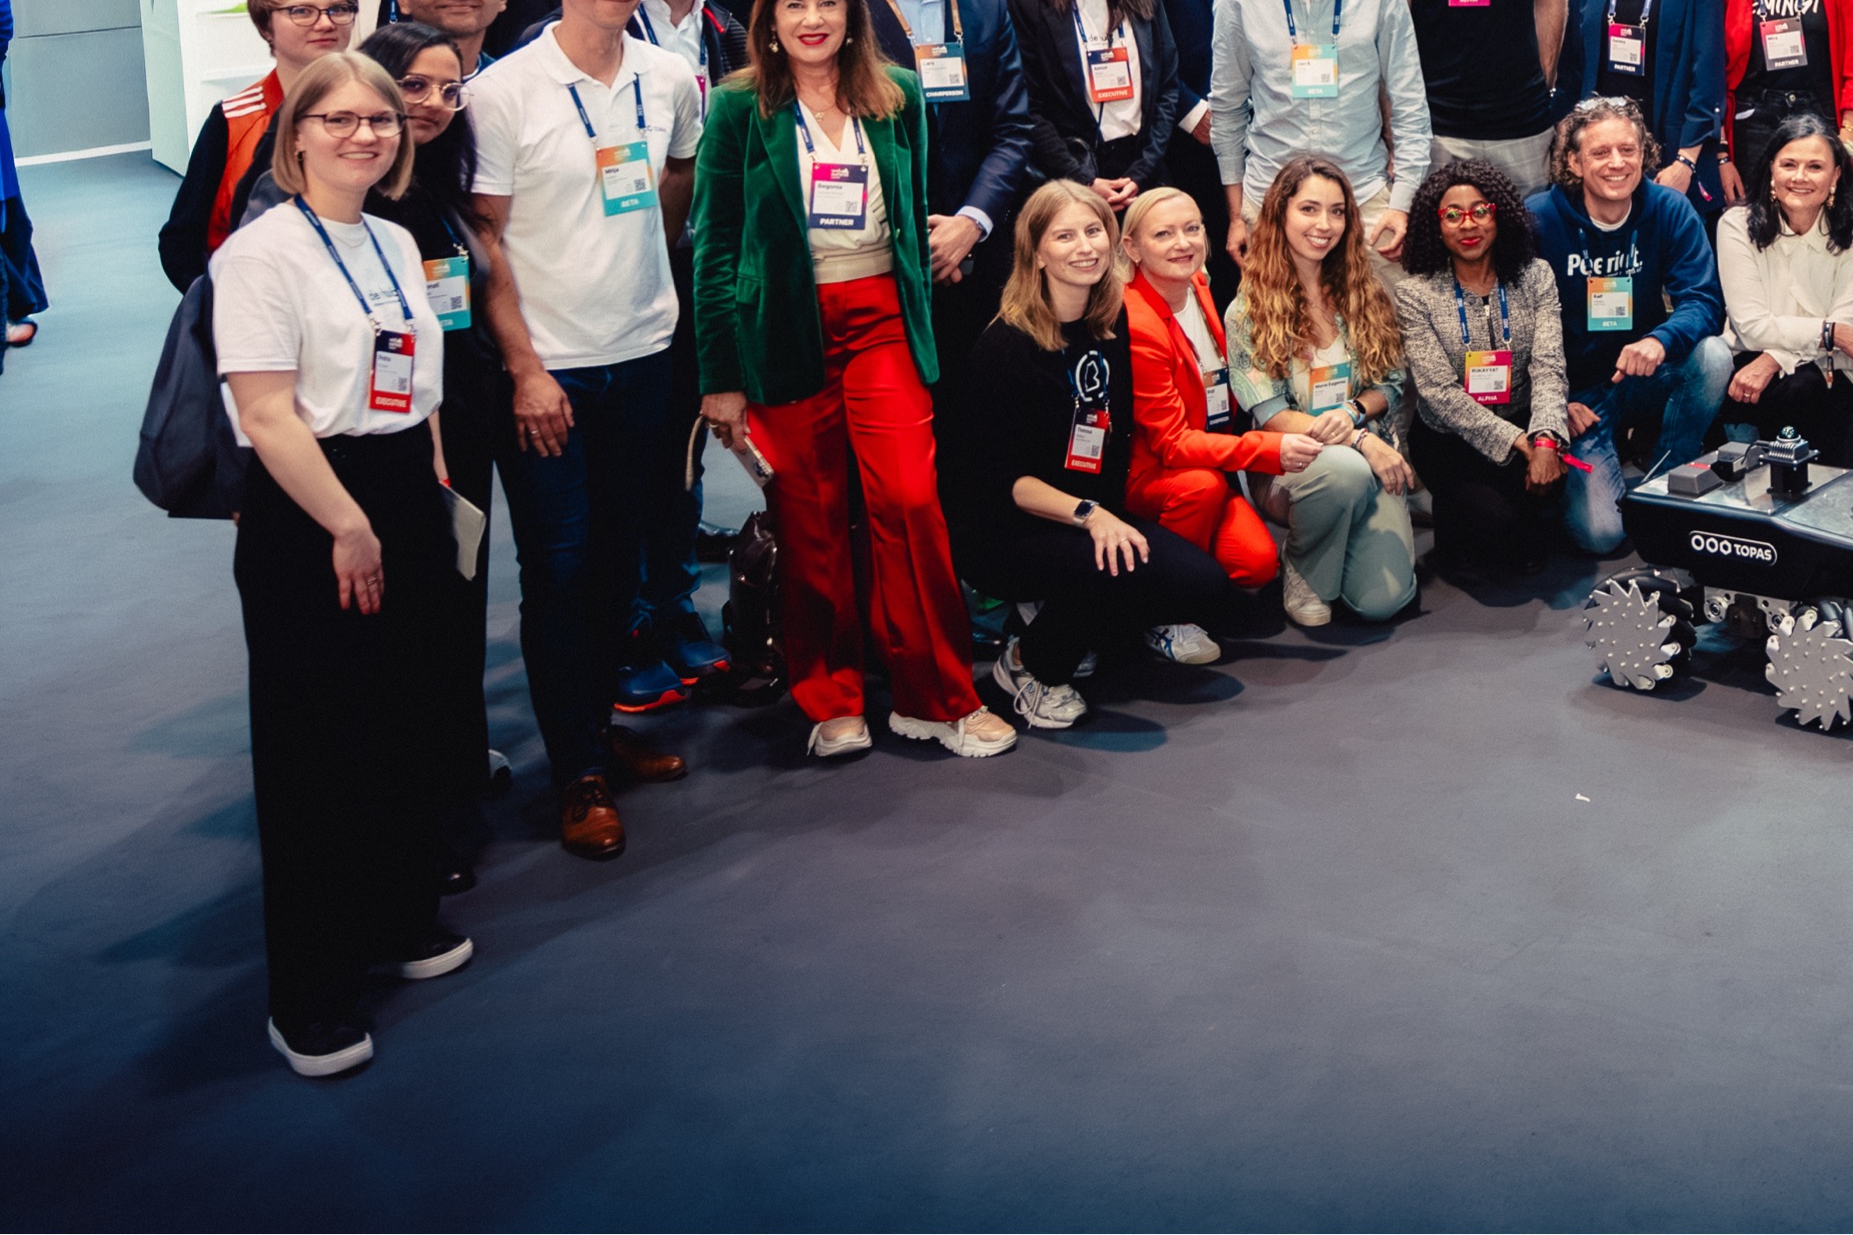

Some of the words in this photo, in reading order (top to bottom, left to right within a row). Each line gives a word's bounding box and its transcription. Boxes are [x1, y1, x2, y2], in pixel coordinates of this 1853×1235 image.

[1614, 63, 1636, 72] PARTNER
[1774, 58, 1799, 68] PARTNER
[925, 89, 964, 98] CHAIRPERSON
[1097, 89, 1128, 99] EXECUTIVE
[819, 217, 855, 227] PARTNER
[1602, 320, 1618, 328] BETA
[375, 396, 407, 409] EXECUTIVE
[1477, 394, 1498, 402] ALPHA
[1071, 459, 1098, 470] EXECUTIVE
[1733, 543, 1773, 561] TOPAS
